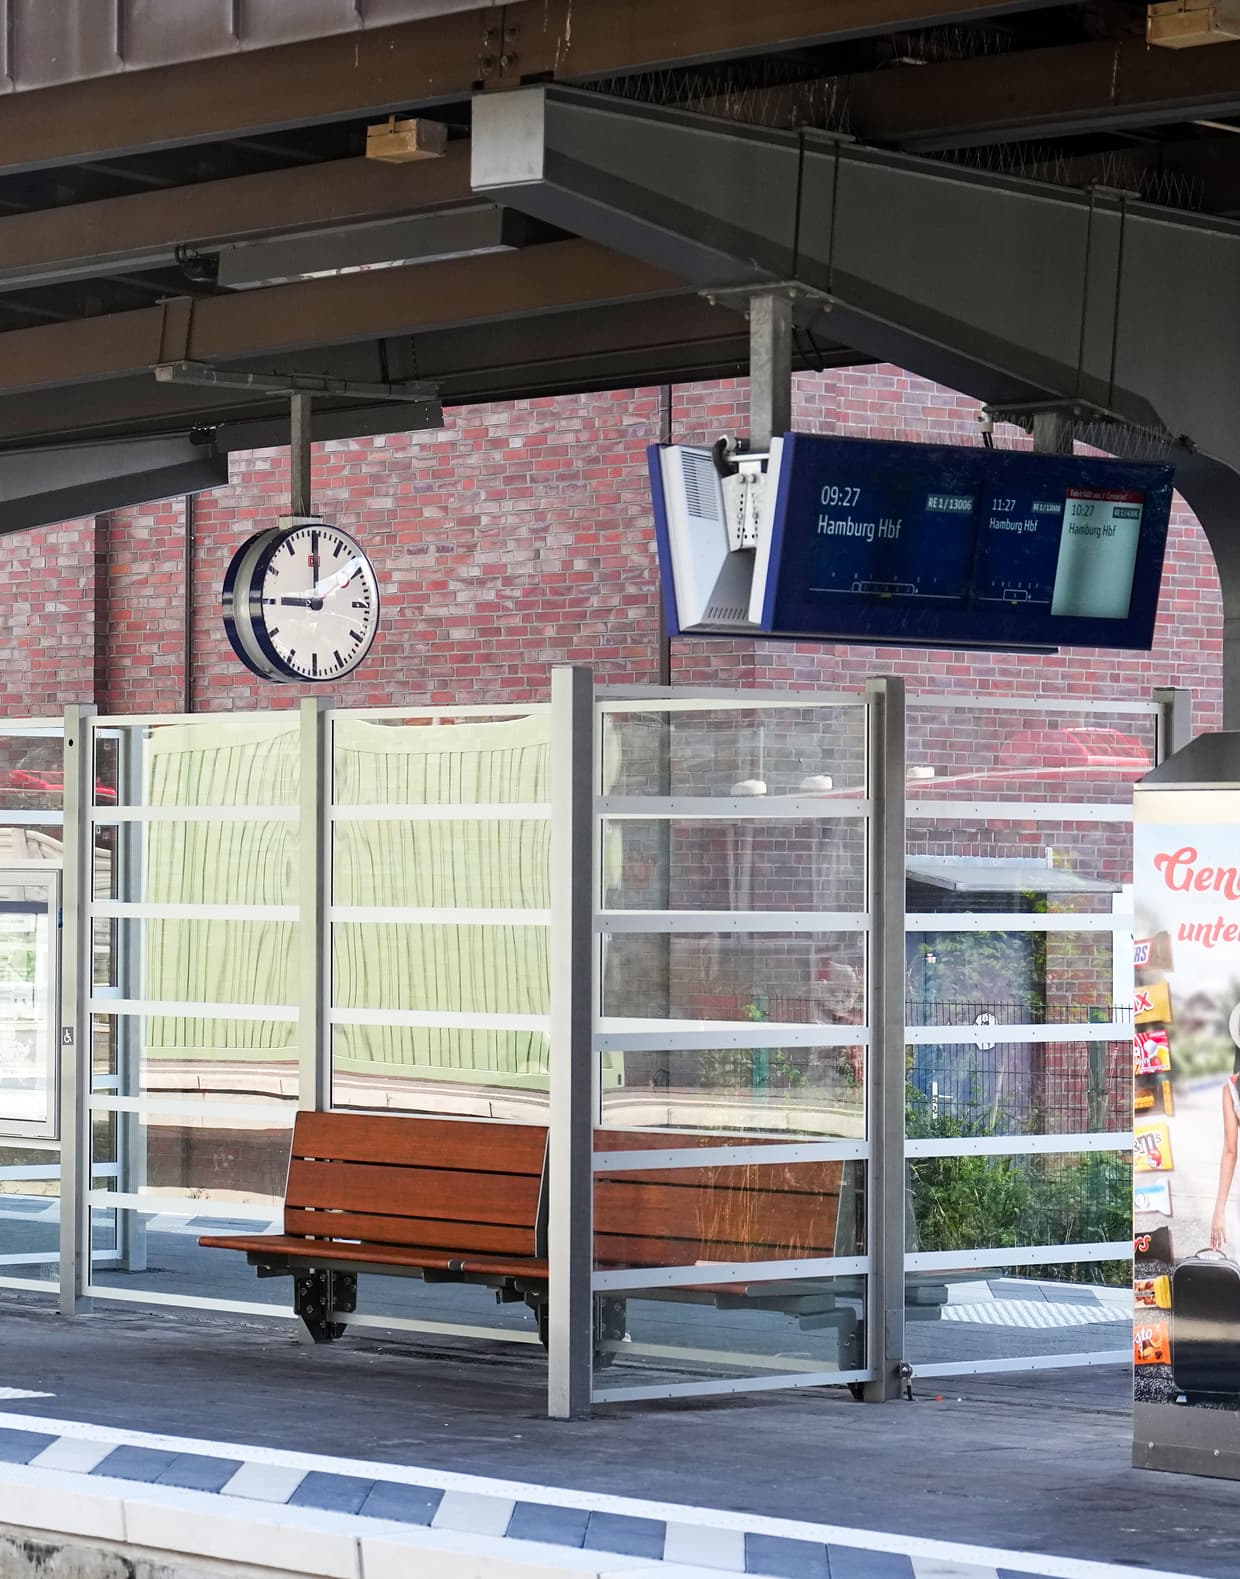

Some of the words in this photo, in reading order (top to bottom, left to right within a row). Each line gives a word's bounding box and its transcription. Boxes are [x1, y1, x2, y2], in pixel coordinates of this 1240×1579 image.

[821, 485, 861, 507] 09:27
[992, 498, 1016, 511] 11:27
[1072, 504, 1095, 517] 10:27
[817, 514, 875, 542] Hamburg
[878, 518, 902, 539] Hbf
[989, 517, 1023, 534] Hamburg
[1023, 519, 1039, 532] Hbf
[1069, 523, 1101, 539] Hamburg
[1102, 525, 1117, 537] Hbf
[1154, 847, 1240, 900] Gen
[1178, 915, 1240, 949] unte
